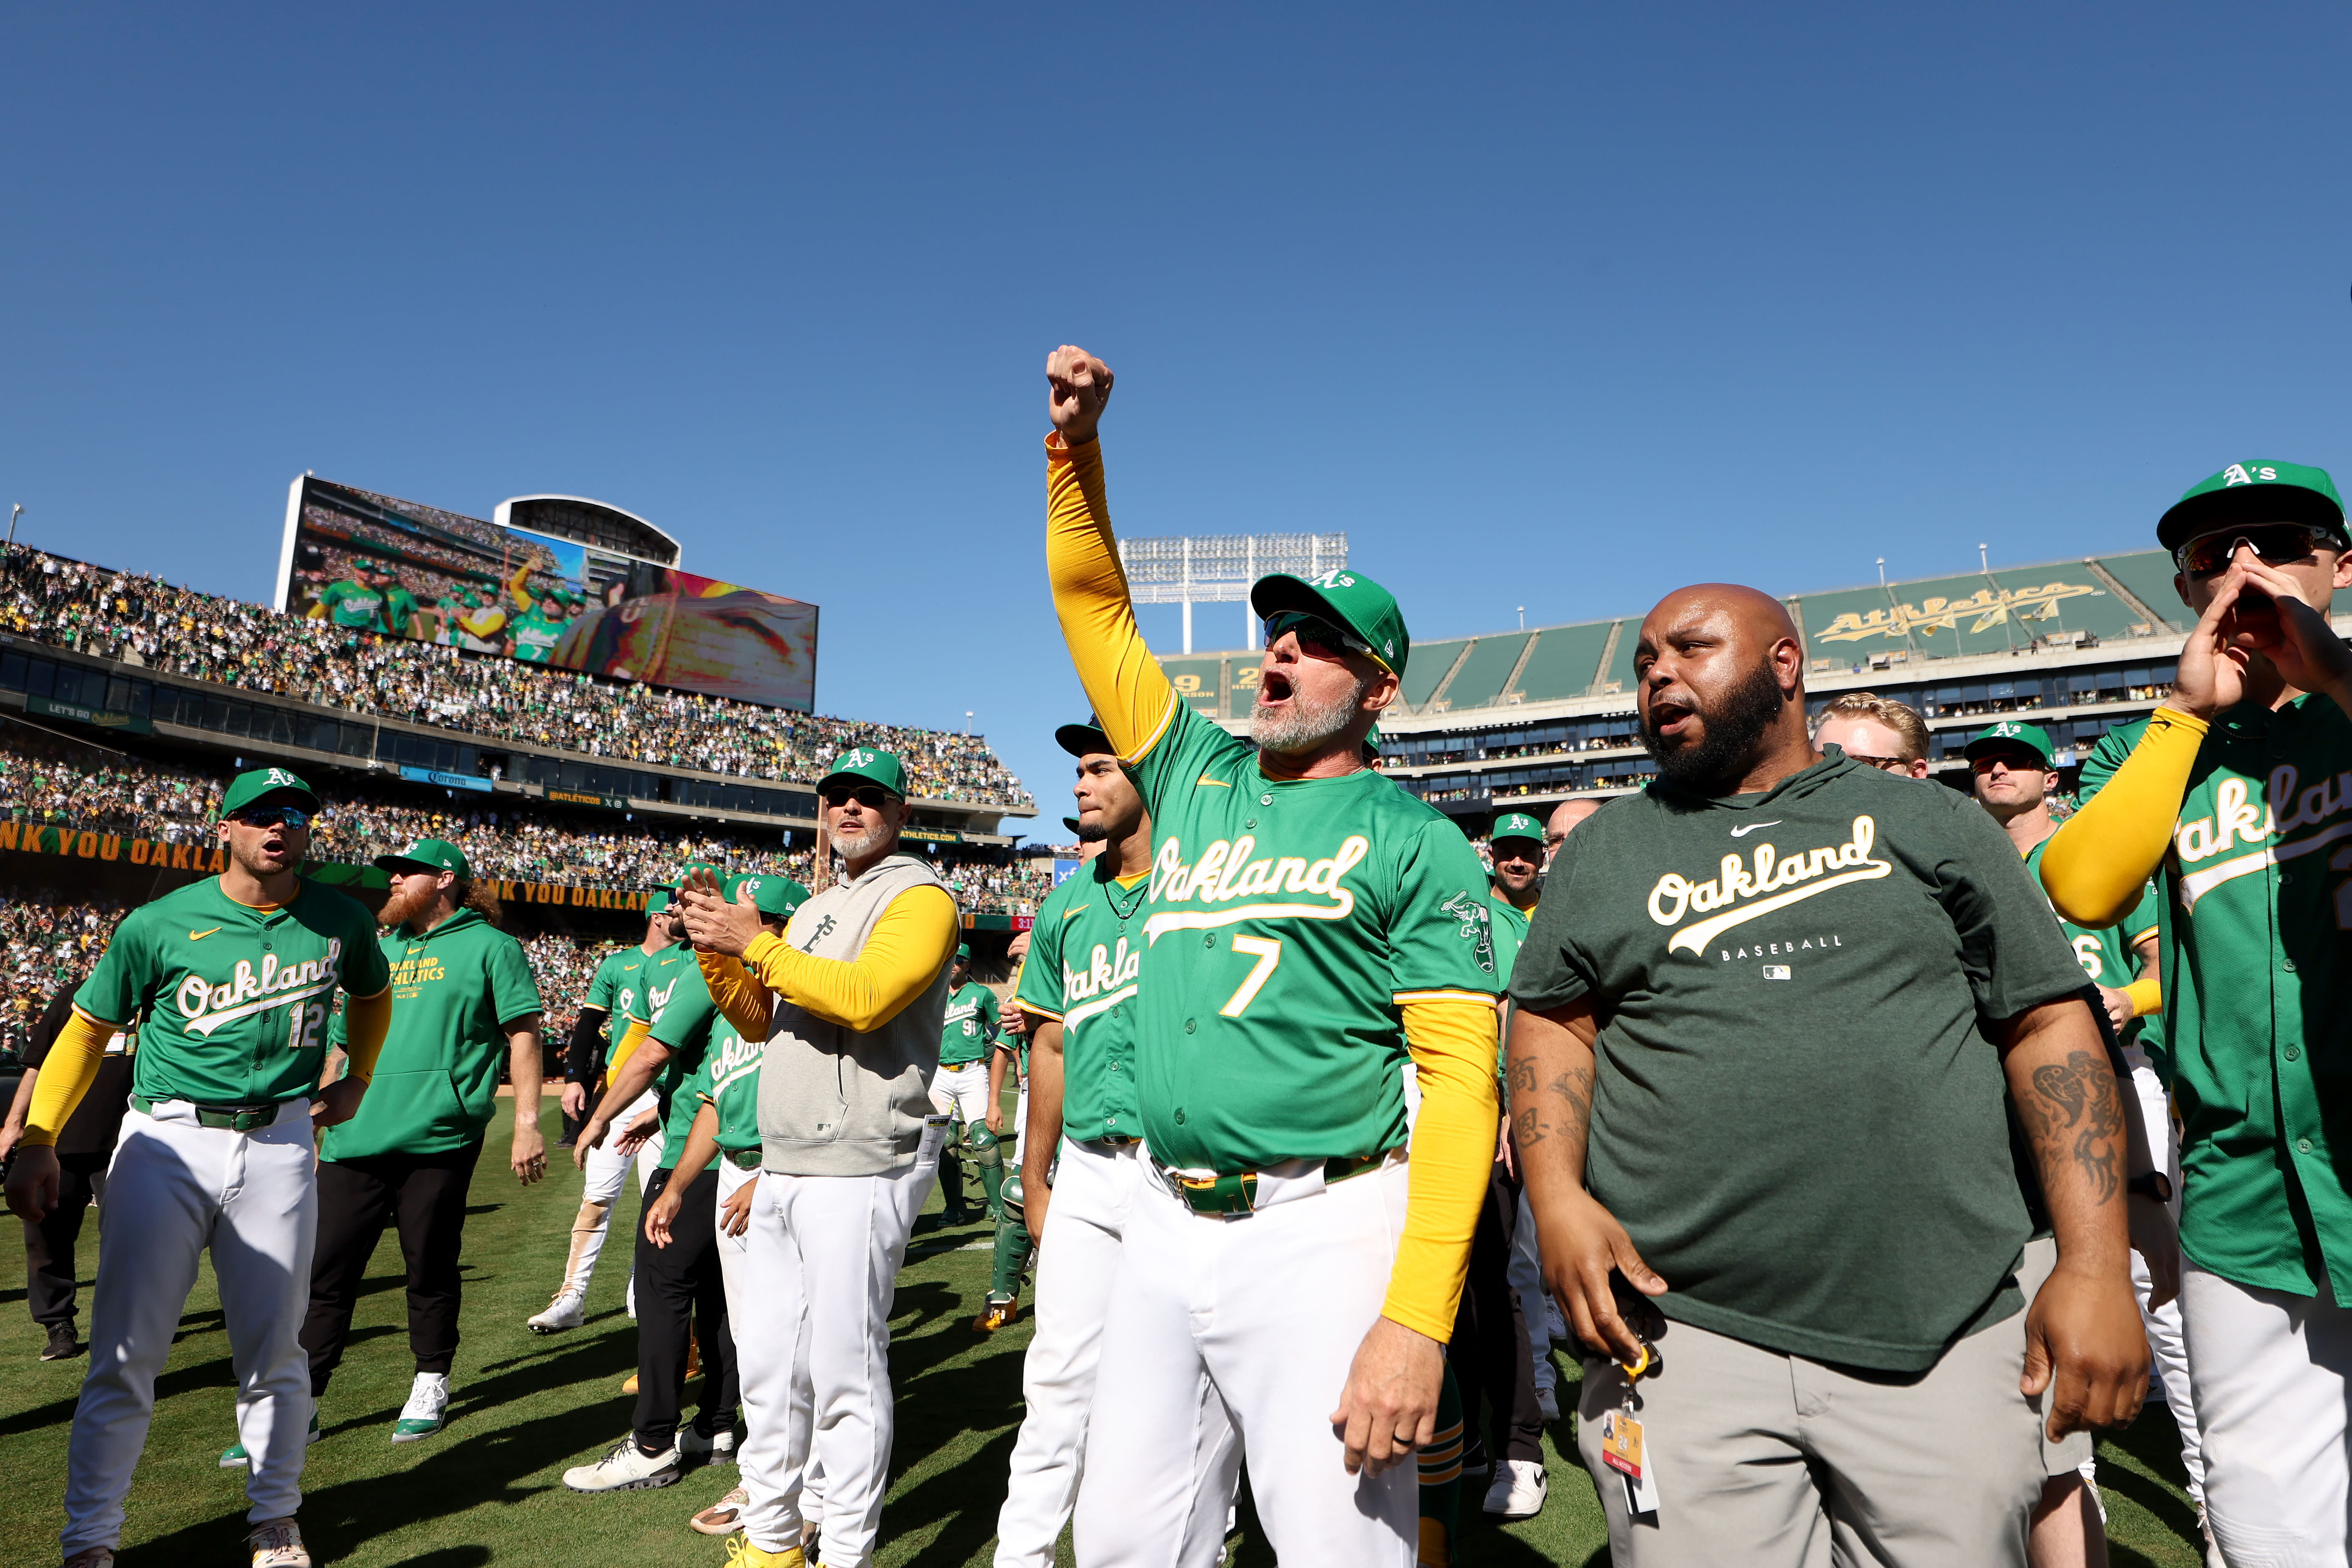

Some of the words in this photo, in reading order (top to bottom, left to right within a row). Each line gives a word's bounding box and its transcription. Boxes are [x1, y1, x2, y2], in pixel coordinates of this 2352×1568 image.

[2223, 463, 2277, 486] A's
[1309, 569, 1356, 589] A's
[1814, 582, 2094, 641] Athletics
[531, 646, 543, 660] 7
[1173, 675, 1201, 692] 9
[49, 704, 75, 716] LET'S
[77, 710, 90, 719] GO
[92, 712, 130, 726] Oakland
[1992, 721, 2021, 737] A's
[842, 748, 875, 771] A's
[262, 768, 296, 786] A's
[428, 771, 466, 786] Corona
[549, 791, 601, 805] @ATLÉTICOS
[1507, 814, 1529, 830] A's
[58, 828, 121, 861] YOU
[900, 830, 956, 842] ATHLETICS.COM
[1147, 835, 1370, 914] Oakland
[1647, 815, 1883, 926] Oakland
[524, 882, 565, 905] YOU
[1722, 935, 1842, 961] BASEBALL
[176, 937, 340, 1021] Oakland
[389, 966, 445, 985] THLETICS
[1218, 934, 1281, 1018] 7
[289, 1002, 326, 1047] 12
[962, 1019, 976, 1036] 91
[1618, 1435, 1628, 1452] 24
